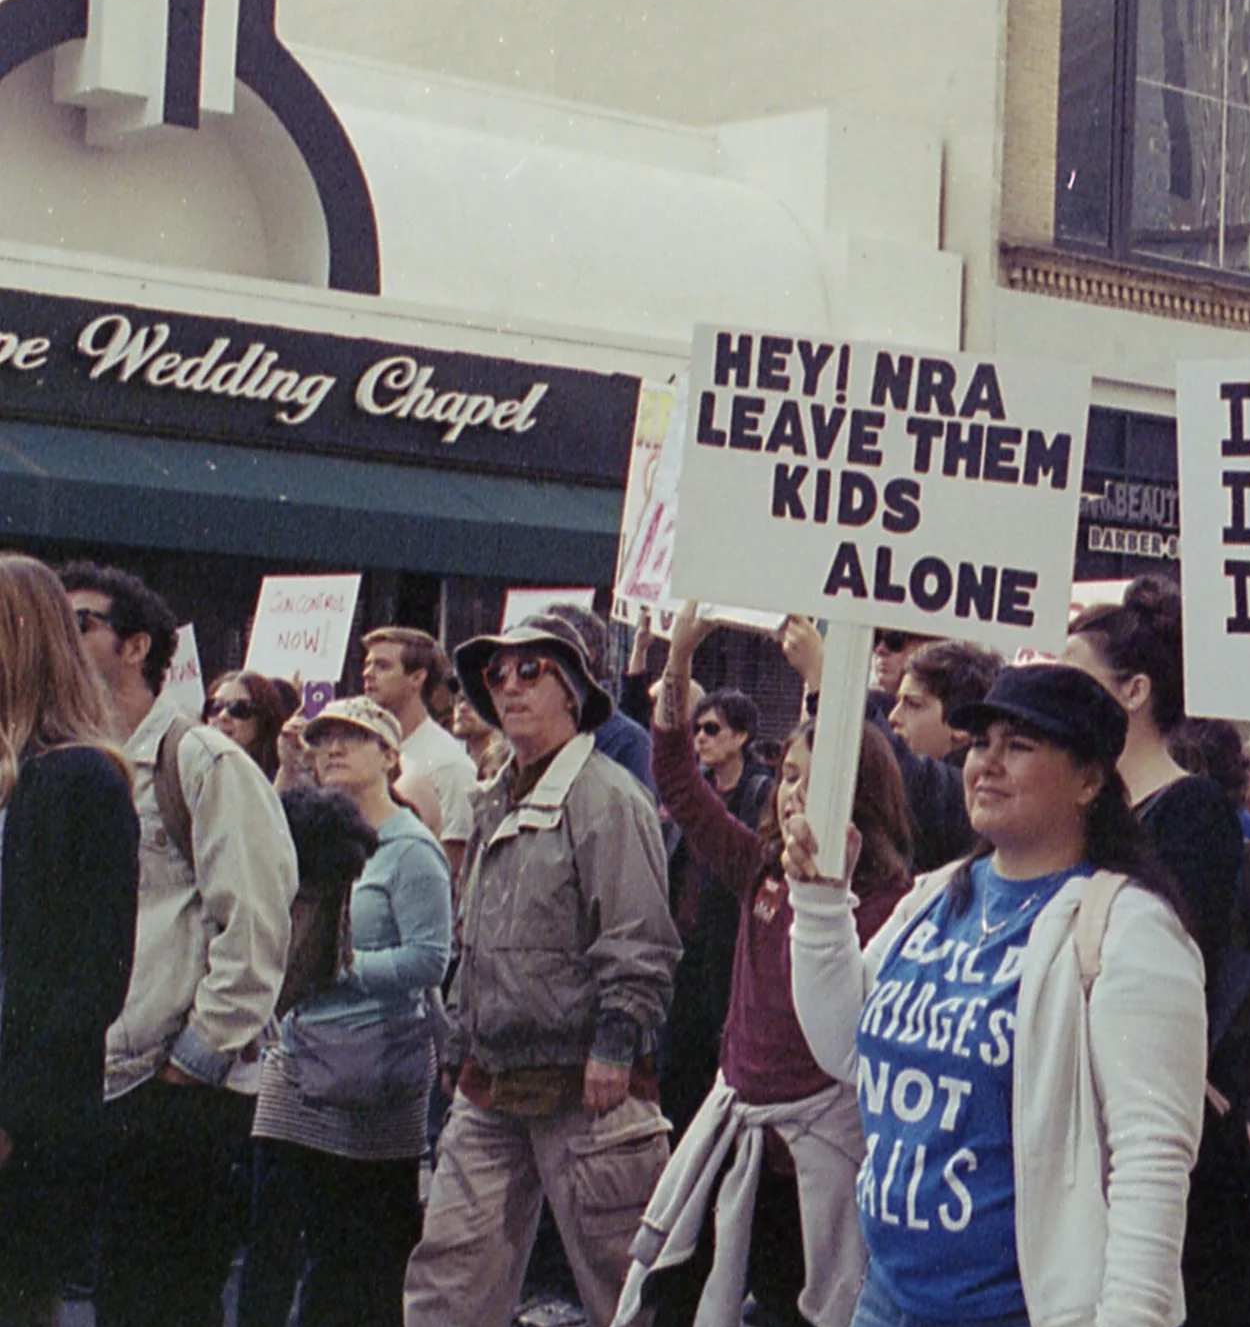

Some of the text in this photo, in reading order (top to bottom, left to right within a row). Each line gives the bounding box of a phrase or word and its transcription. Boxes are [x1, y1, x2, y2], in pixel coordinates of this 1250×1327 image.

[78, 314, 549, 443] Wedding Chapel
[713, 331, 1006, 421] HEY! NRA
[696, 392, 1072, 490] LEAVE THEM
[771, 462, 921, 534] KIDS
[822, 541, 1038, 627] ALONE
[1088, 526, 1163, 557] BARBER
[901, 920, 1025, 985] BUILD
[861, 980, 1017, 1067] RIDGES
[857, 1055, 973, 1131] NOT
[856, 1133, 978, 1232] ALLS
